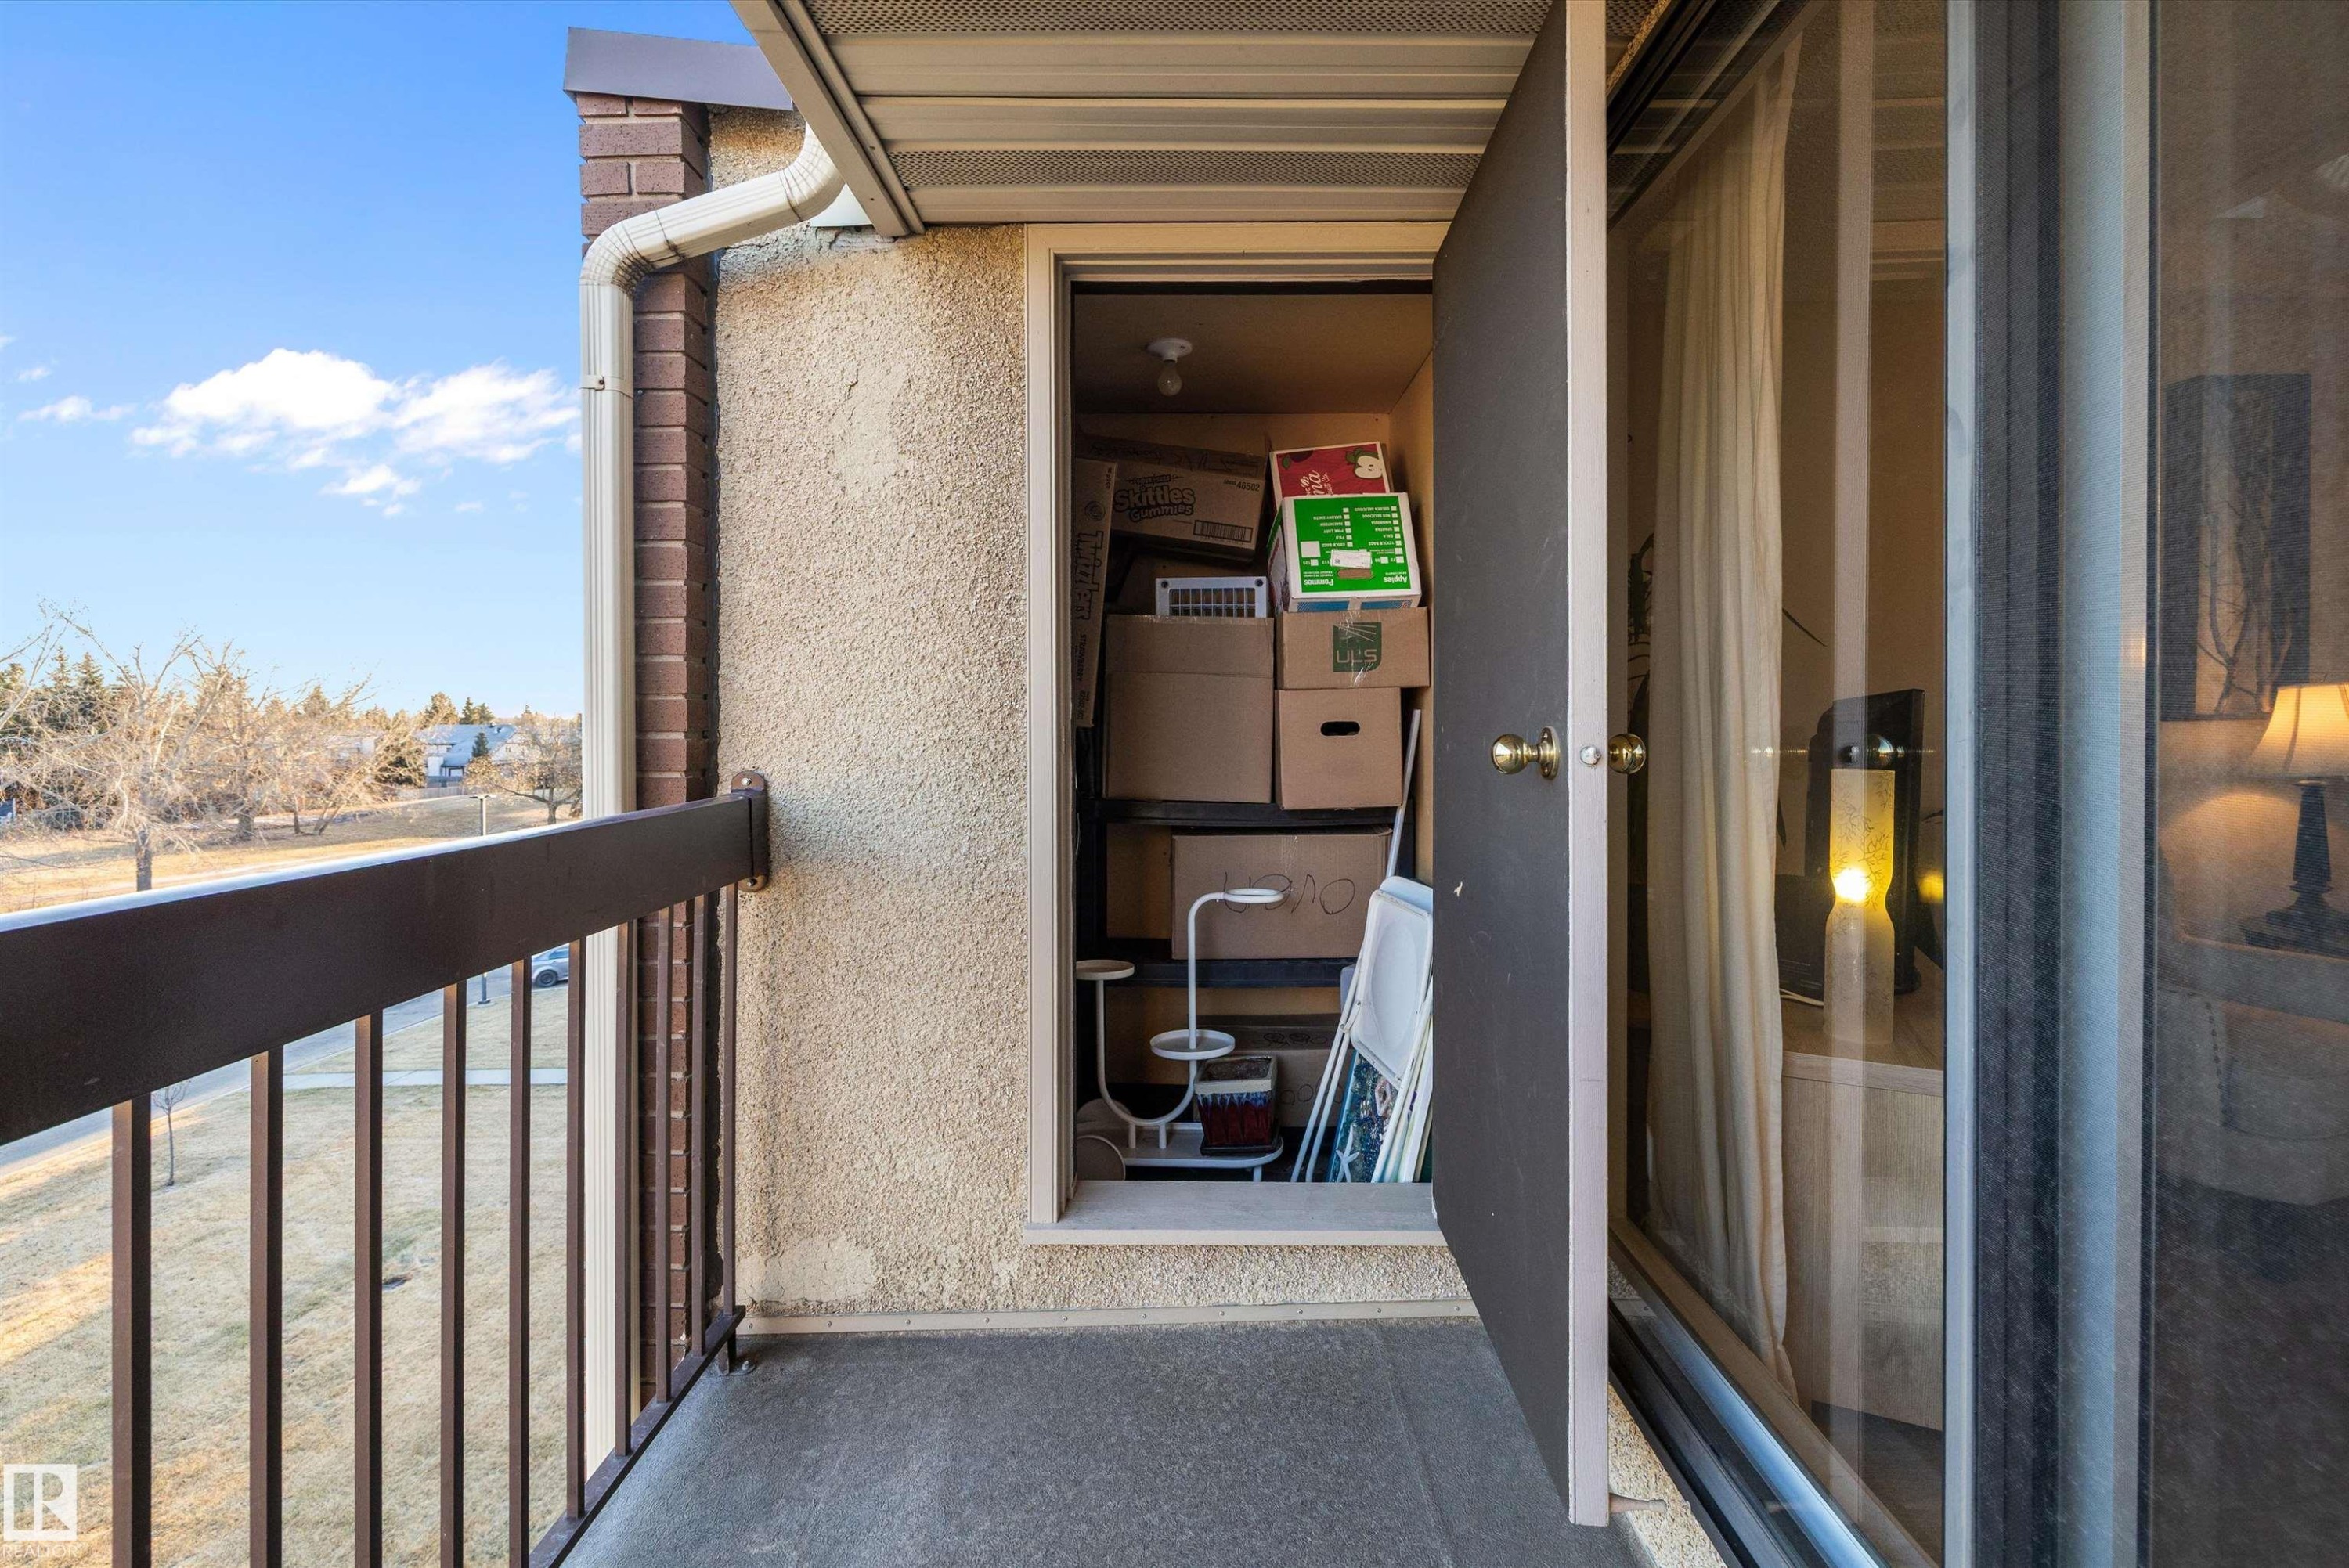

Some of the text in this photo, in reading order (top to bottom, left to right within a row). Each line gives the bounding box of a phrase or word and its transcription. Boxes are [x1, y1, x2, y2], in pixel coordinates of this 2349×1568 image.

[1236, 480, 1260, 492] 46502
[1113, 484, 1196, 513] Skittles
[1128, 503, 1194, 523] Gummies
[1383, 575, 1408, 584] Apples
[1336, 649, 1377, 664] ULS
